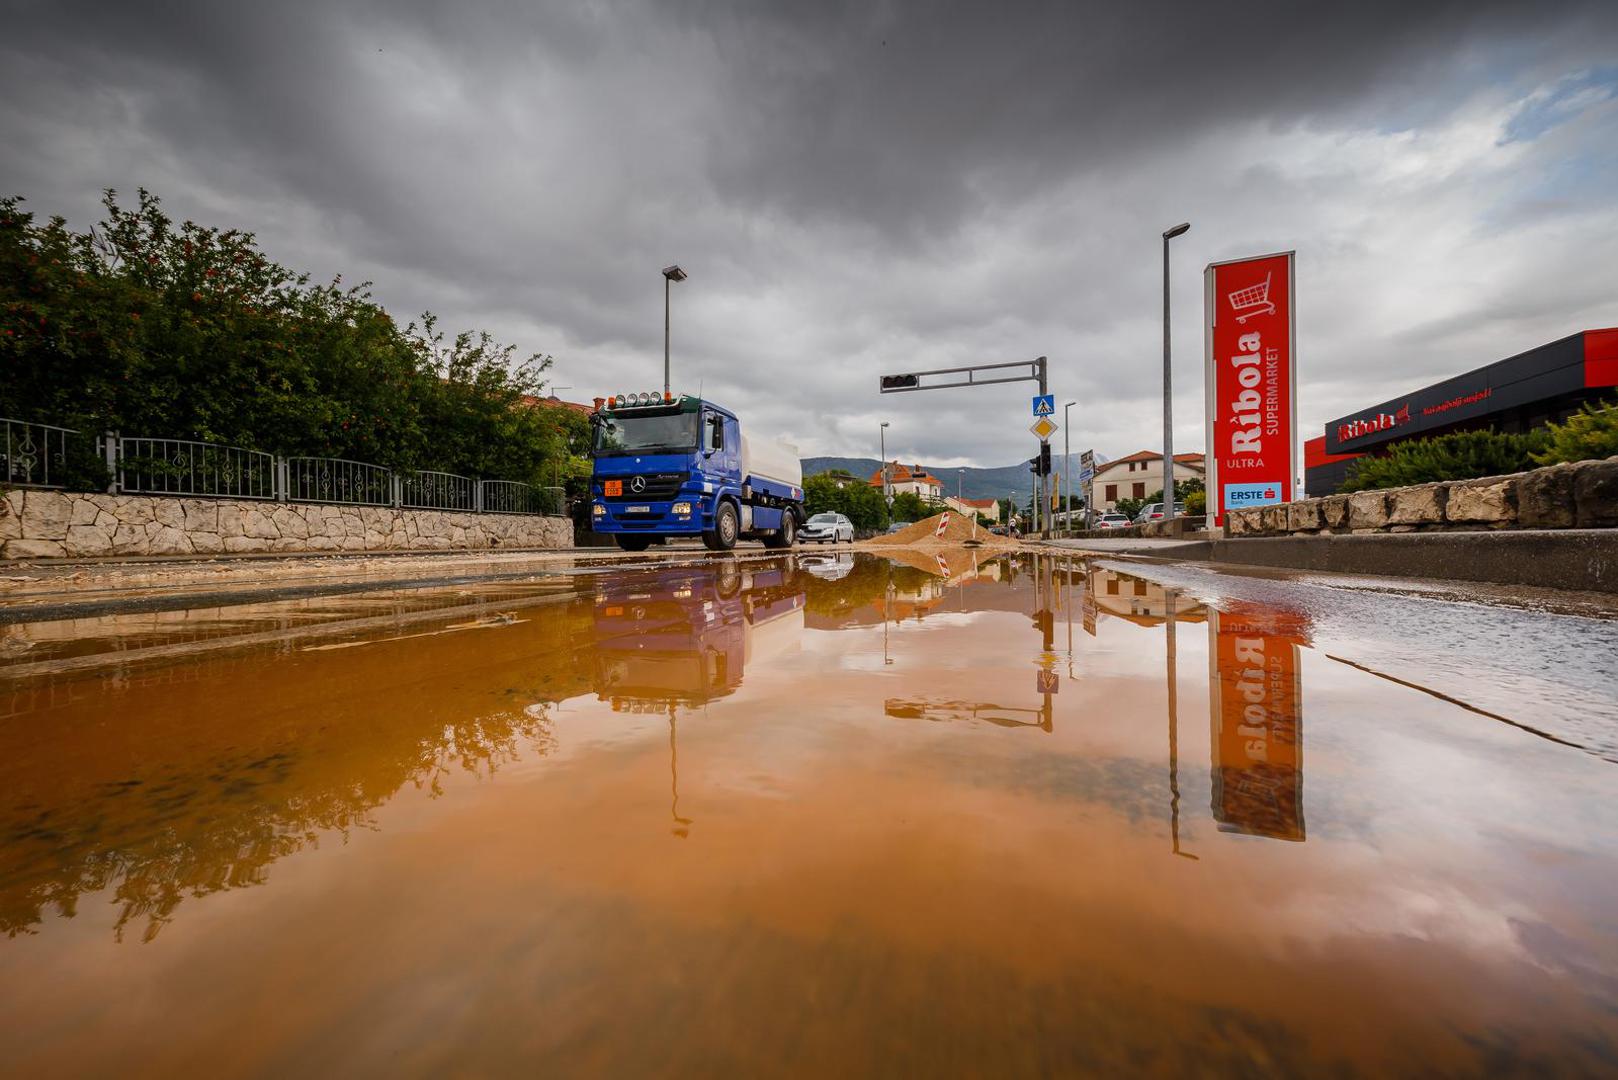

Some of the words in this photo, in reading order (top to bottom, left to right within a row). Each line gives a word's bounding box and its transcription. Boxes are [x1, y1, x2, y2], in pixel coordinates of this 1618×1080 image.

[1230, 331, 1262, 454] Ribola
[1266, 347, 1279, 436] SUPERMARKET
[1337, 413, 1395, 442] Ribola
[1227, 458, 1265, 468] ULTRA
[1231, 491, 1262, 499] ERSTE
